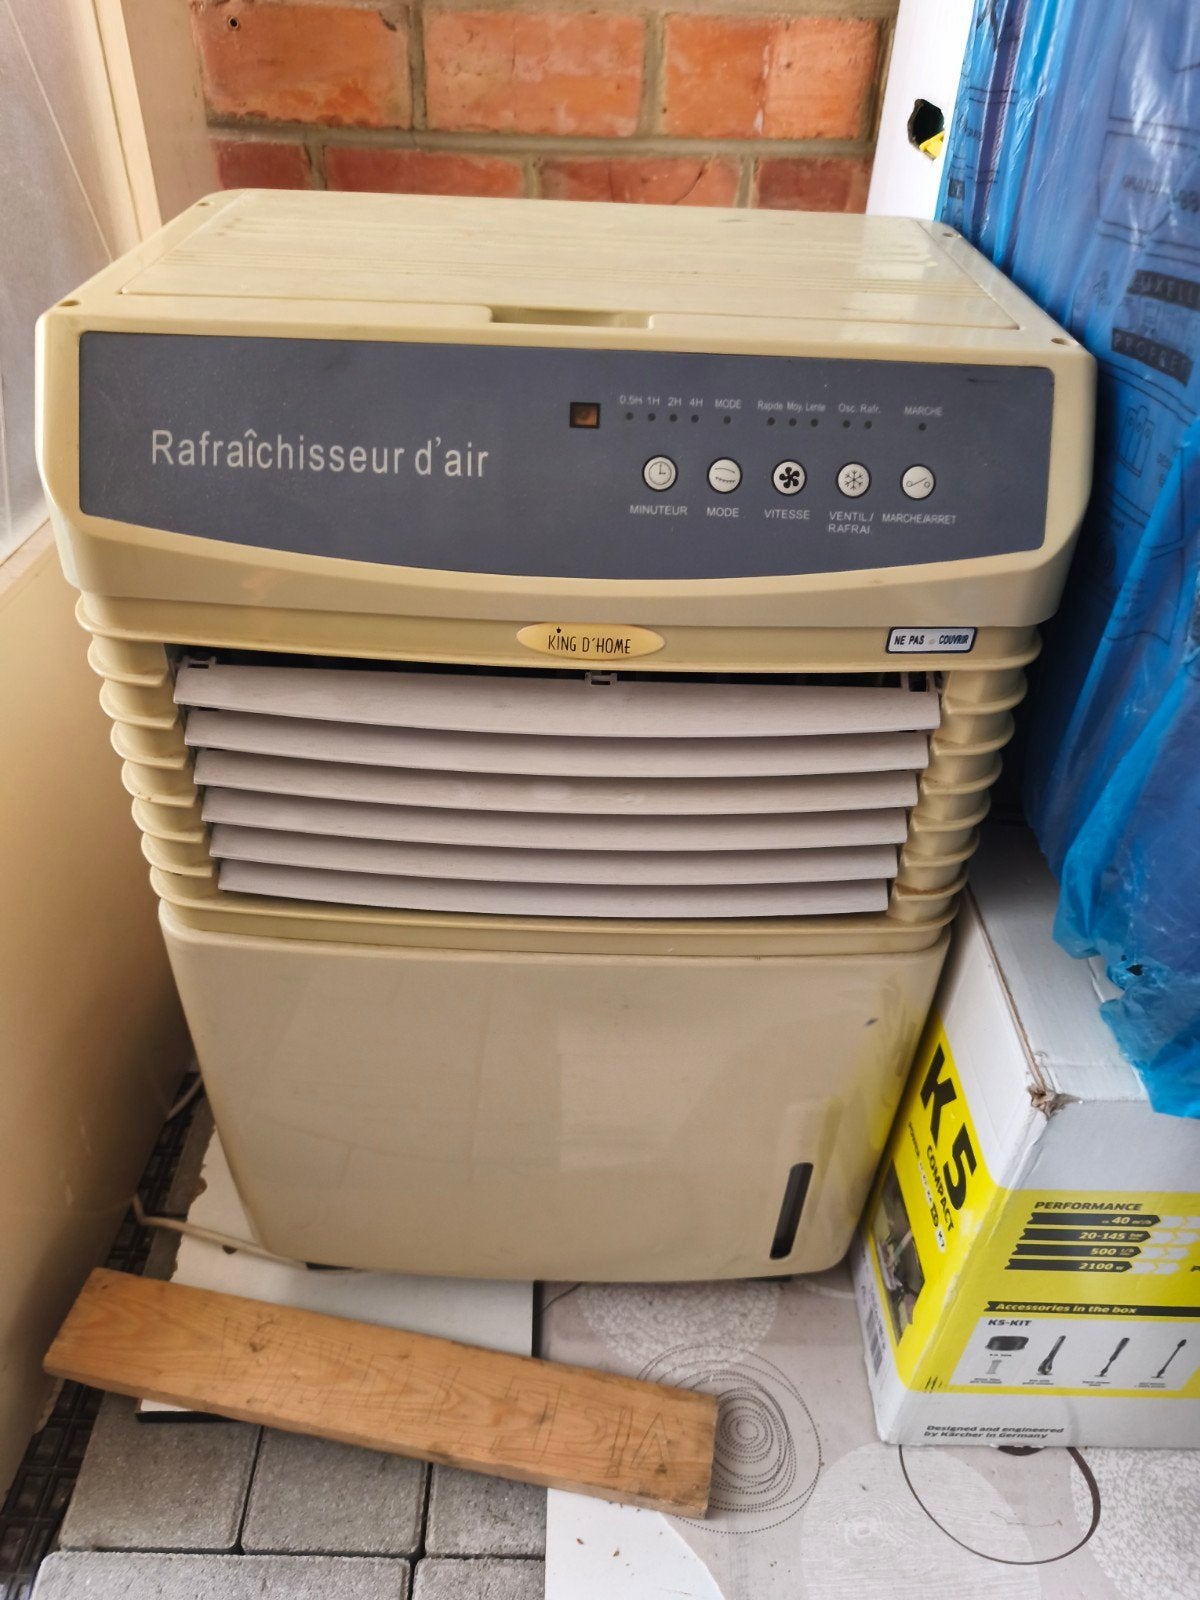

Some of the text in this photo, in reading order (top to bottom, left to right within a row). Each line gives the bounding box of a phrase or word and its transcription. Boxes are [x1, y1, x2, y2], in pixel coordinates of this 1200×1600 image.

[620, 394, 703, 407] 0.5H 1H 2H 4H
[714, 398, 741, 409] MODE
[904, 406, 942, 416] MARCHE
[151, 428, 405, 474] Rafraîchisseur
[630, 504, 688, 516] MINUTEUR
[706, 506, 739, 517] MODE
[763, 509, 810, 520] VITESSE
[881, 513, 956, 524] MARCHE/ARRET
[548, 631, 576, 652] KING
[894, 634, 969, 645] NE PAS COUVRIR
[926, 1144, 955, 1231] COMPACT
[1034, 1201, 1143, 1211] PERFORMANCE
[1111, 1216, 1130, 1225] 40
[1079, 1231, 1125, 1241] 20-145
[1090, 1247, 1117, 1256] 500
[1078, 1262, 1114, 1271] 2100
[994, 1303, 1138, 1315] Accessories in the box
[926, 1425, 978, 1433] Designed
